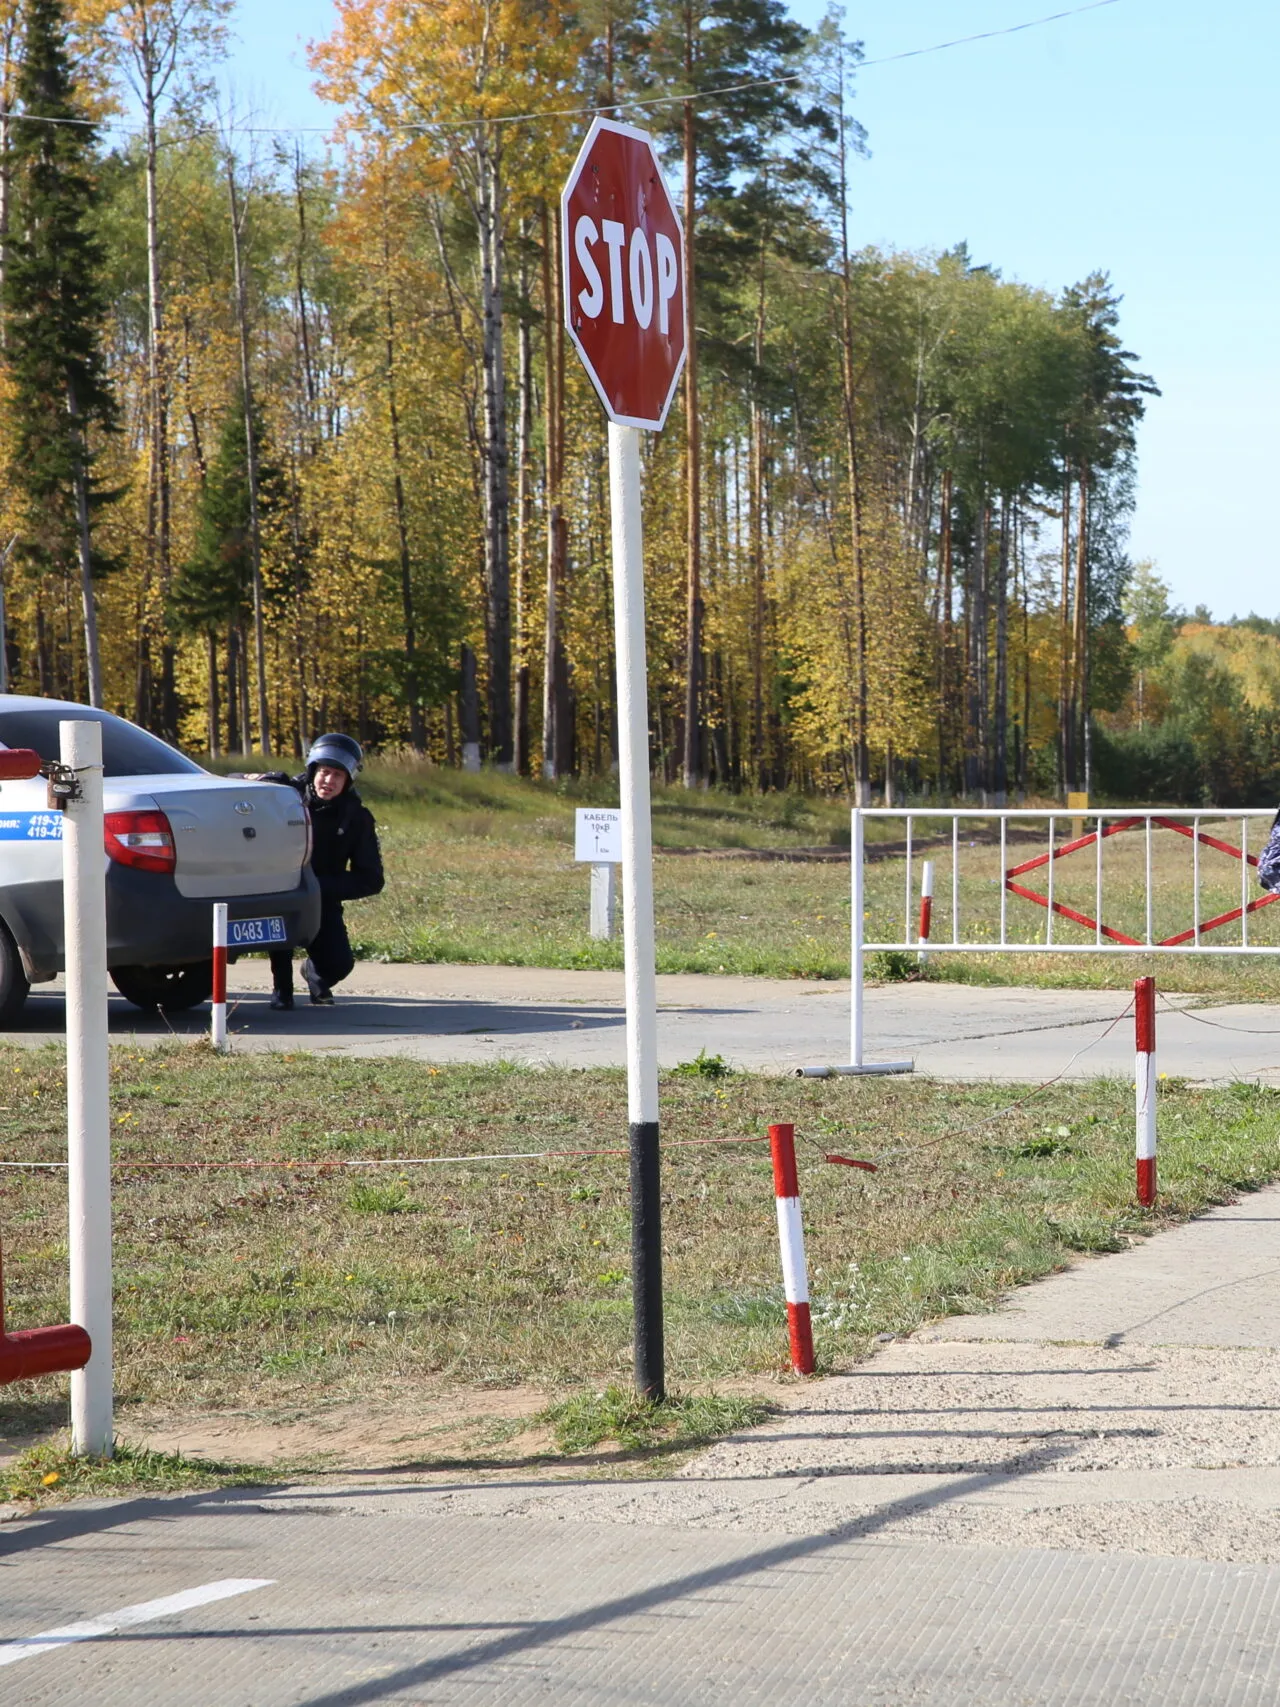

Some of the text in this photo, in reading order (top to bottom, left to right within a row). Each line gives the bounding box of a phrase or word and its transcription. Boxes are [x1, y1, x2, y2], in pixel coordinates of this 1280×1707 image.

[575, 214, 678, 335] STOP
[584, 813, 618, 821] КАБЕЛЬ
[233, 919, 281, 941] 0483 18
